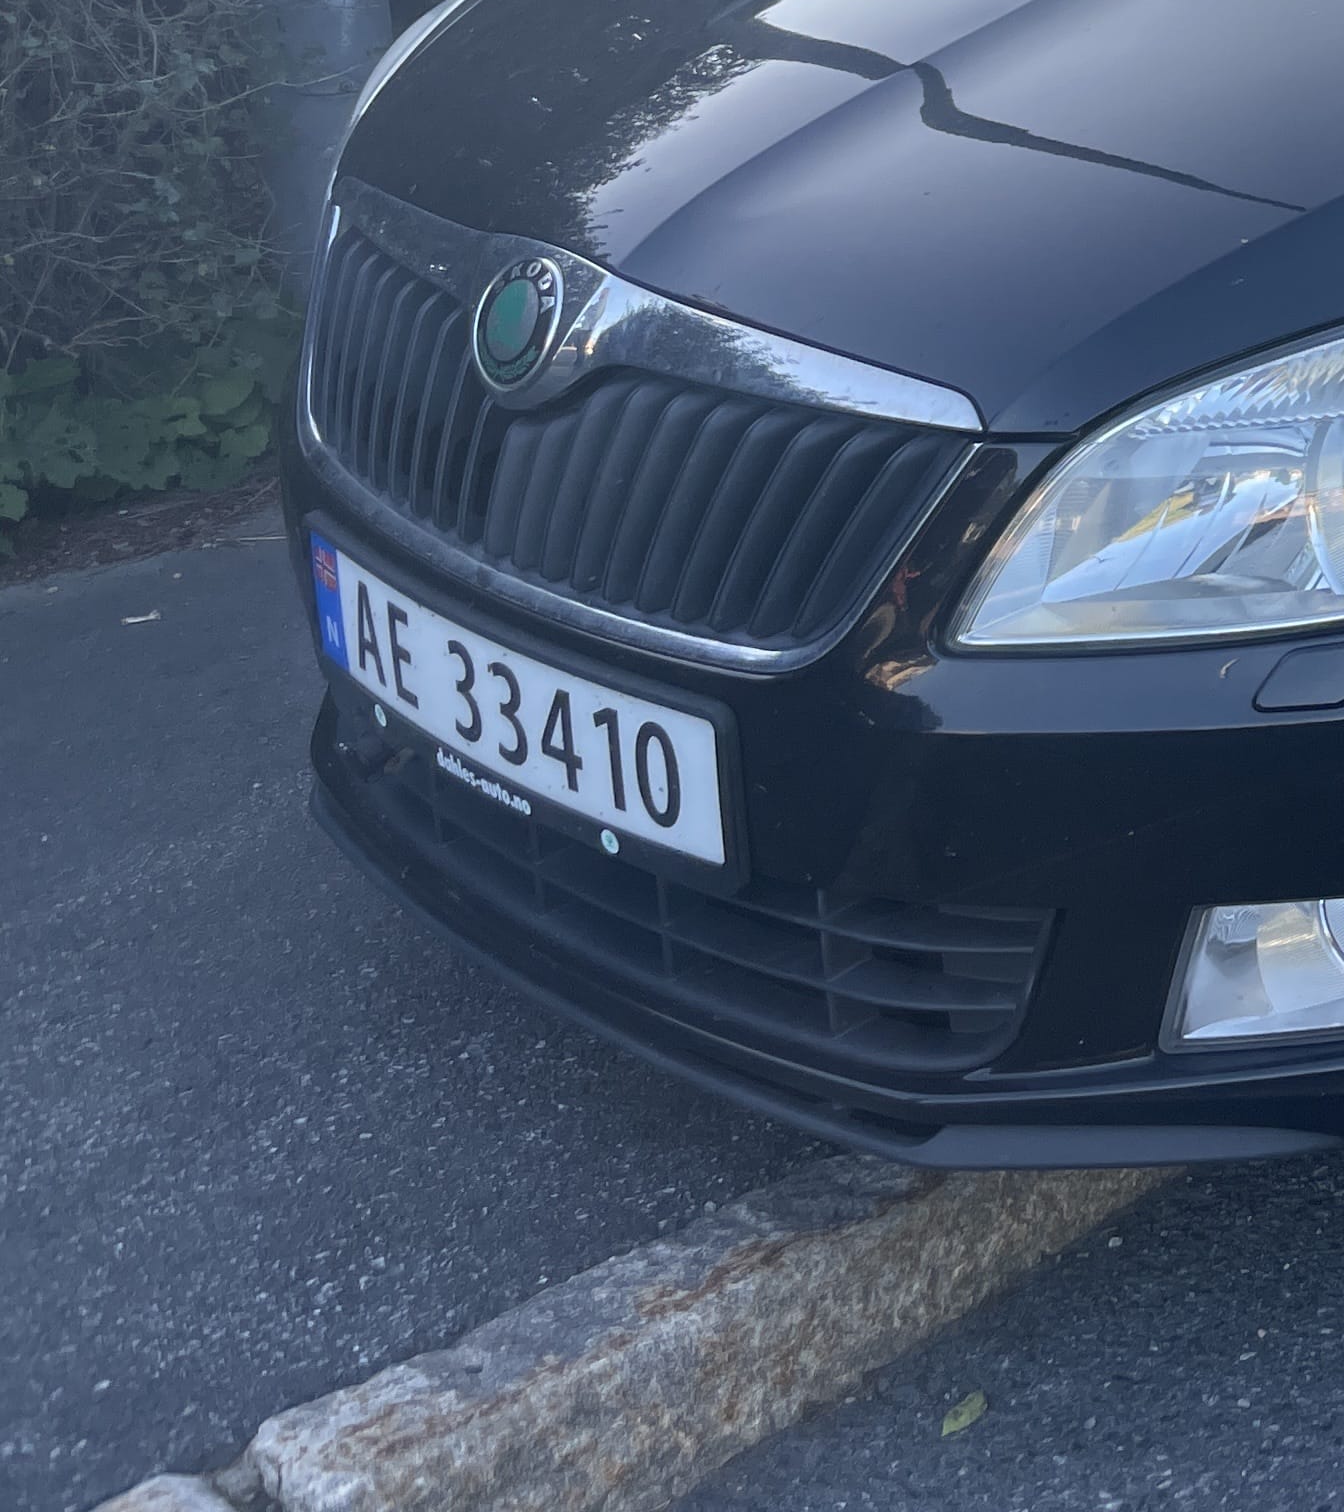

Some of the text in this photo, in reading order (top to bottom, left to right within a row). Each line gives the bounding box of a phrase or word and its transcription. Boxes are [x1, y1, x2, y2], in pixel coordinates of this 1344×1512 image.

[325, 615, 340, 647] N
[357, 580, 681, 828] AE 33410
